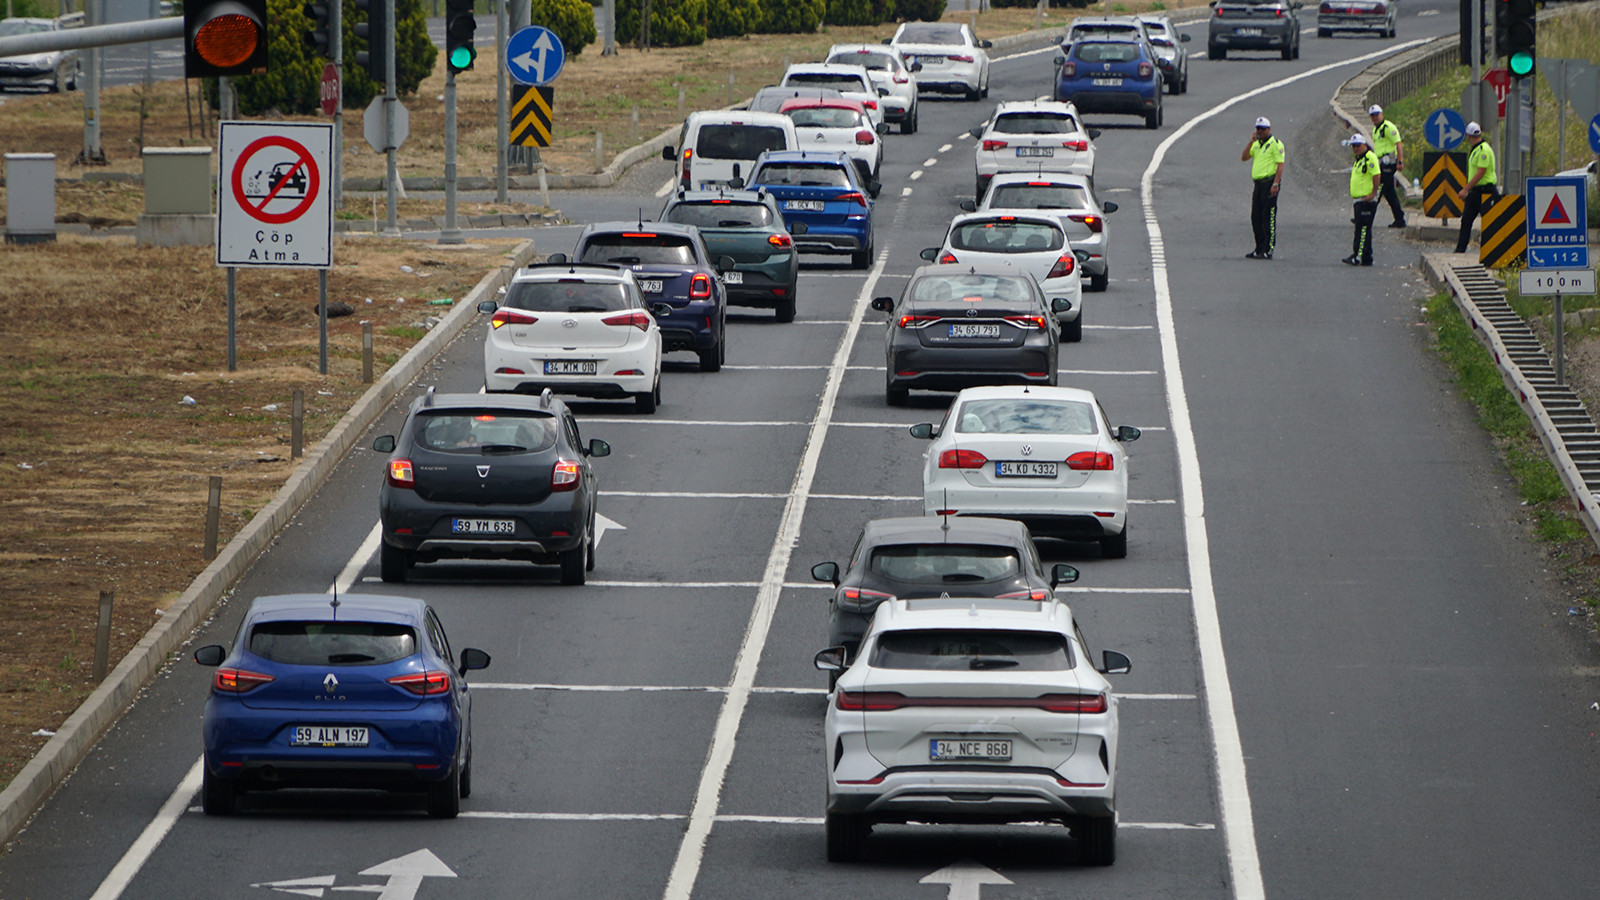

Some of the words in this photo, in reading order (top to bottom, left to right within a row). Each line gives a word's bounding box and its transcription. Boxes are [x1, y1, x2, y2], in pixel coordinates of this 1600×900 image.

[320, 80, 338, 102] DUR
[255, 230, 293, 245] Çöp
[1530, 233, 1584, 243] Jandarma
[248, 248, 299, 261] Atma
[1553, 252, 1579, 262] 112
[728, 272, 741, 281] 670
[647, 282, 661, 290] 763
[953, 325, 963, 334] 34
[983, 325, 998, 335] 793
[549, 362, 558, 372] 34
[582, 362, 594, 372] 010
[1001, 463, 1013, 473] 34
[1016, 463, 1028, 474] KD
[1032, 464, 1055, 474] 4332
[457, 520, 471, 531] 59
[475, 520, 489, 531] YM
[493, 521, 513, 532] 635
[296, 728, 312, 741] 59
[318, 728, 340, 742] ALN
[345, 728, 366, 742] 197
[939, 743, 955, 754] 34
[959, 742, 980, 755] NCE
[986, 743, 1008, 755] 868
